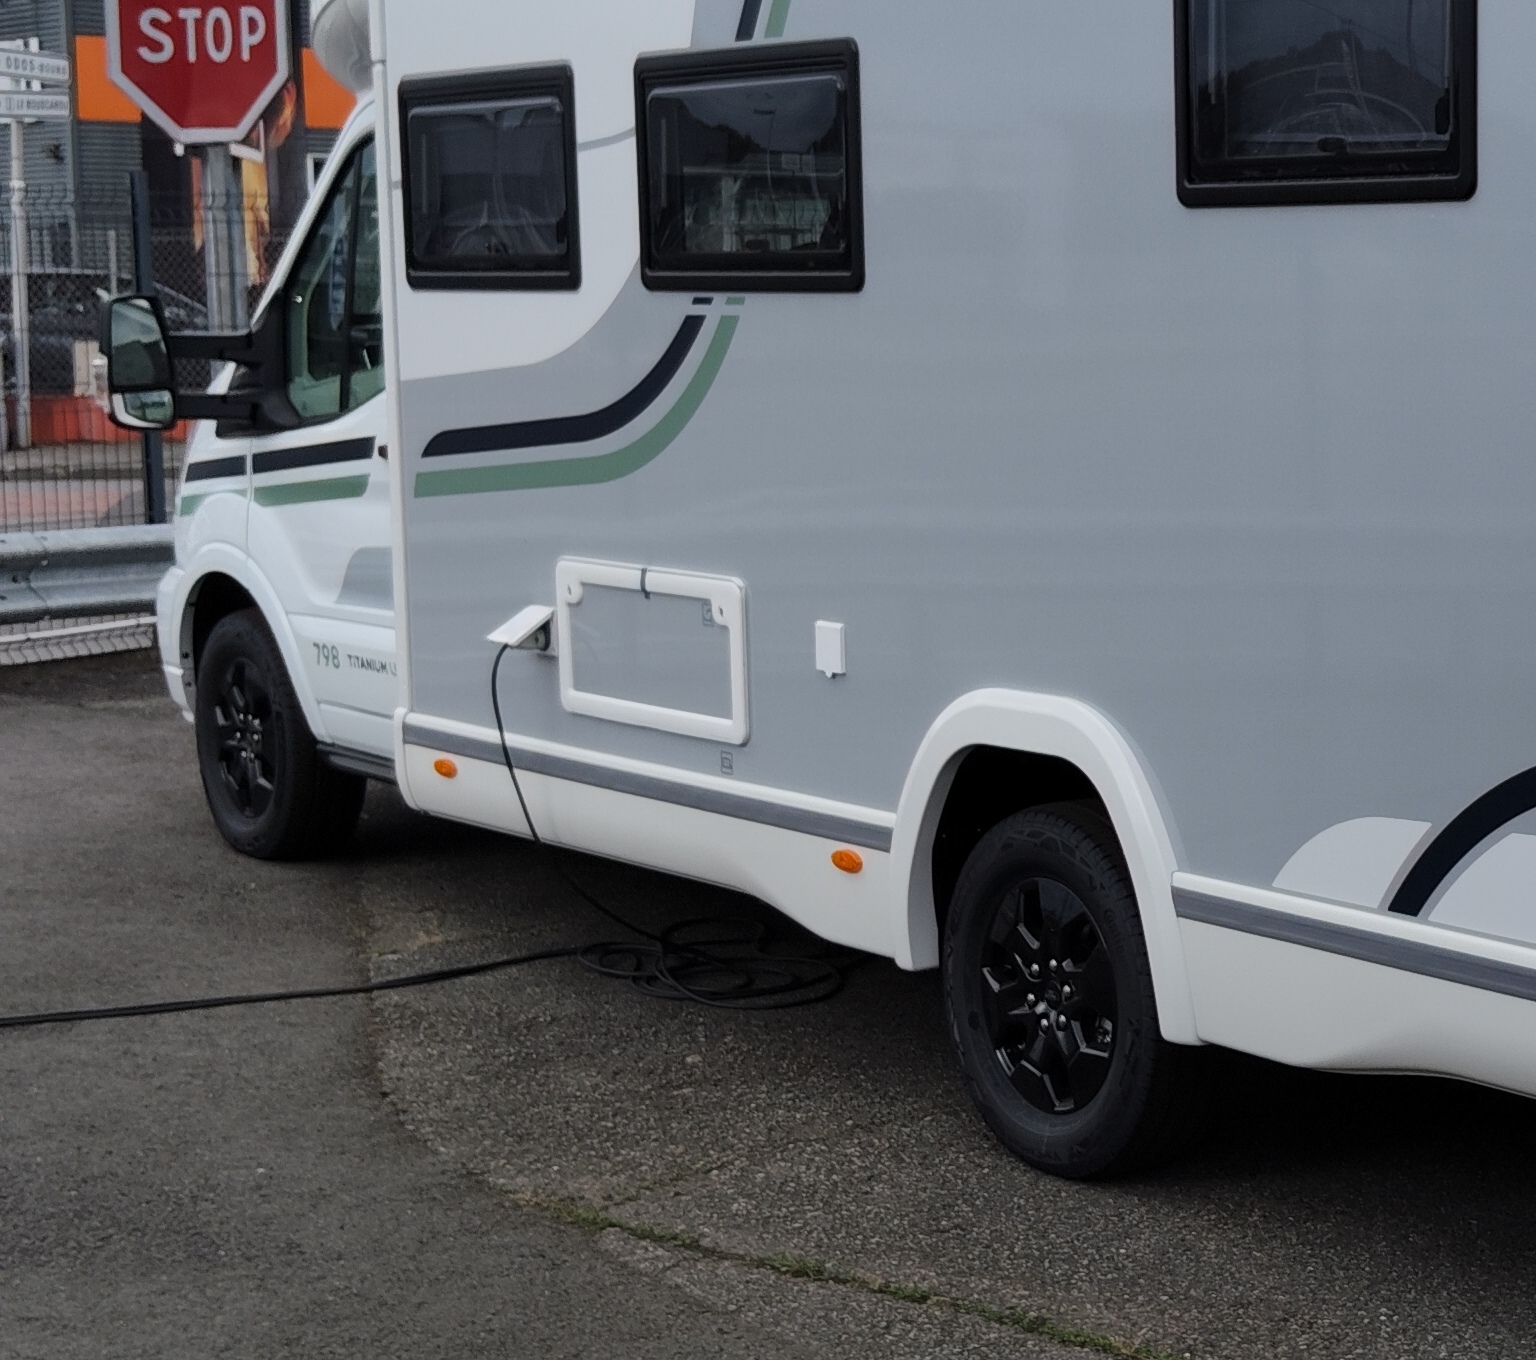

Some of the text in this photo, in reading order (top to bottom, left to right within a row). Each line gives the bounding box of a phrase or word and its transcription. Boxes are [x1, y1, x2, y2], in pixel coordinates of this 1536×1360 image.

[137, 6, 267, 64] STOP
[312, 641, 340, 669] 798
[347, 653, 388, 675] TITANIUM
